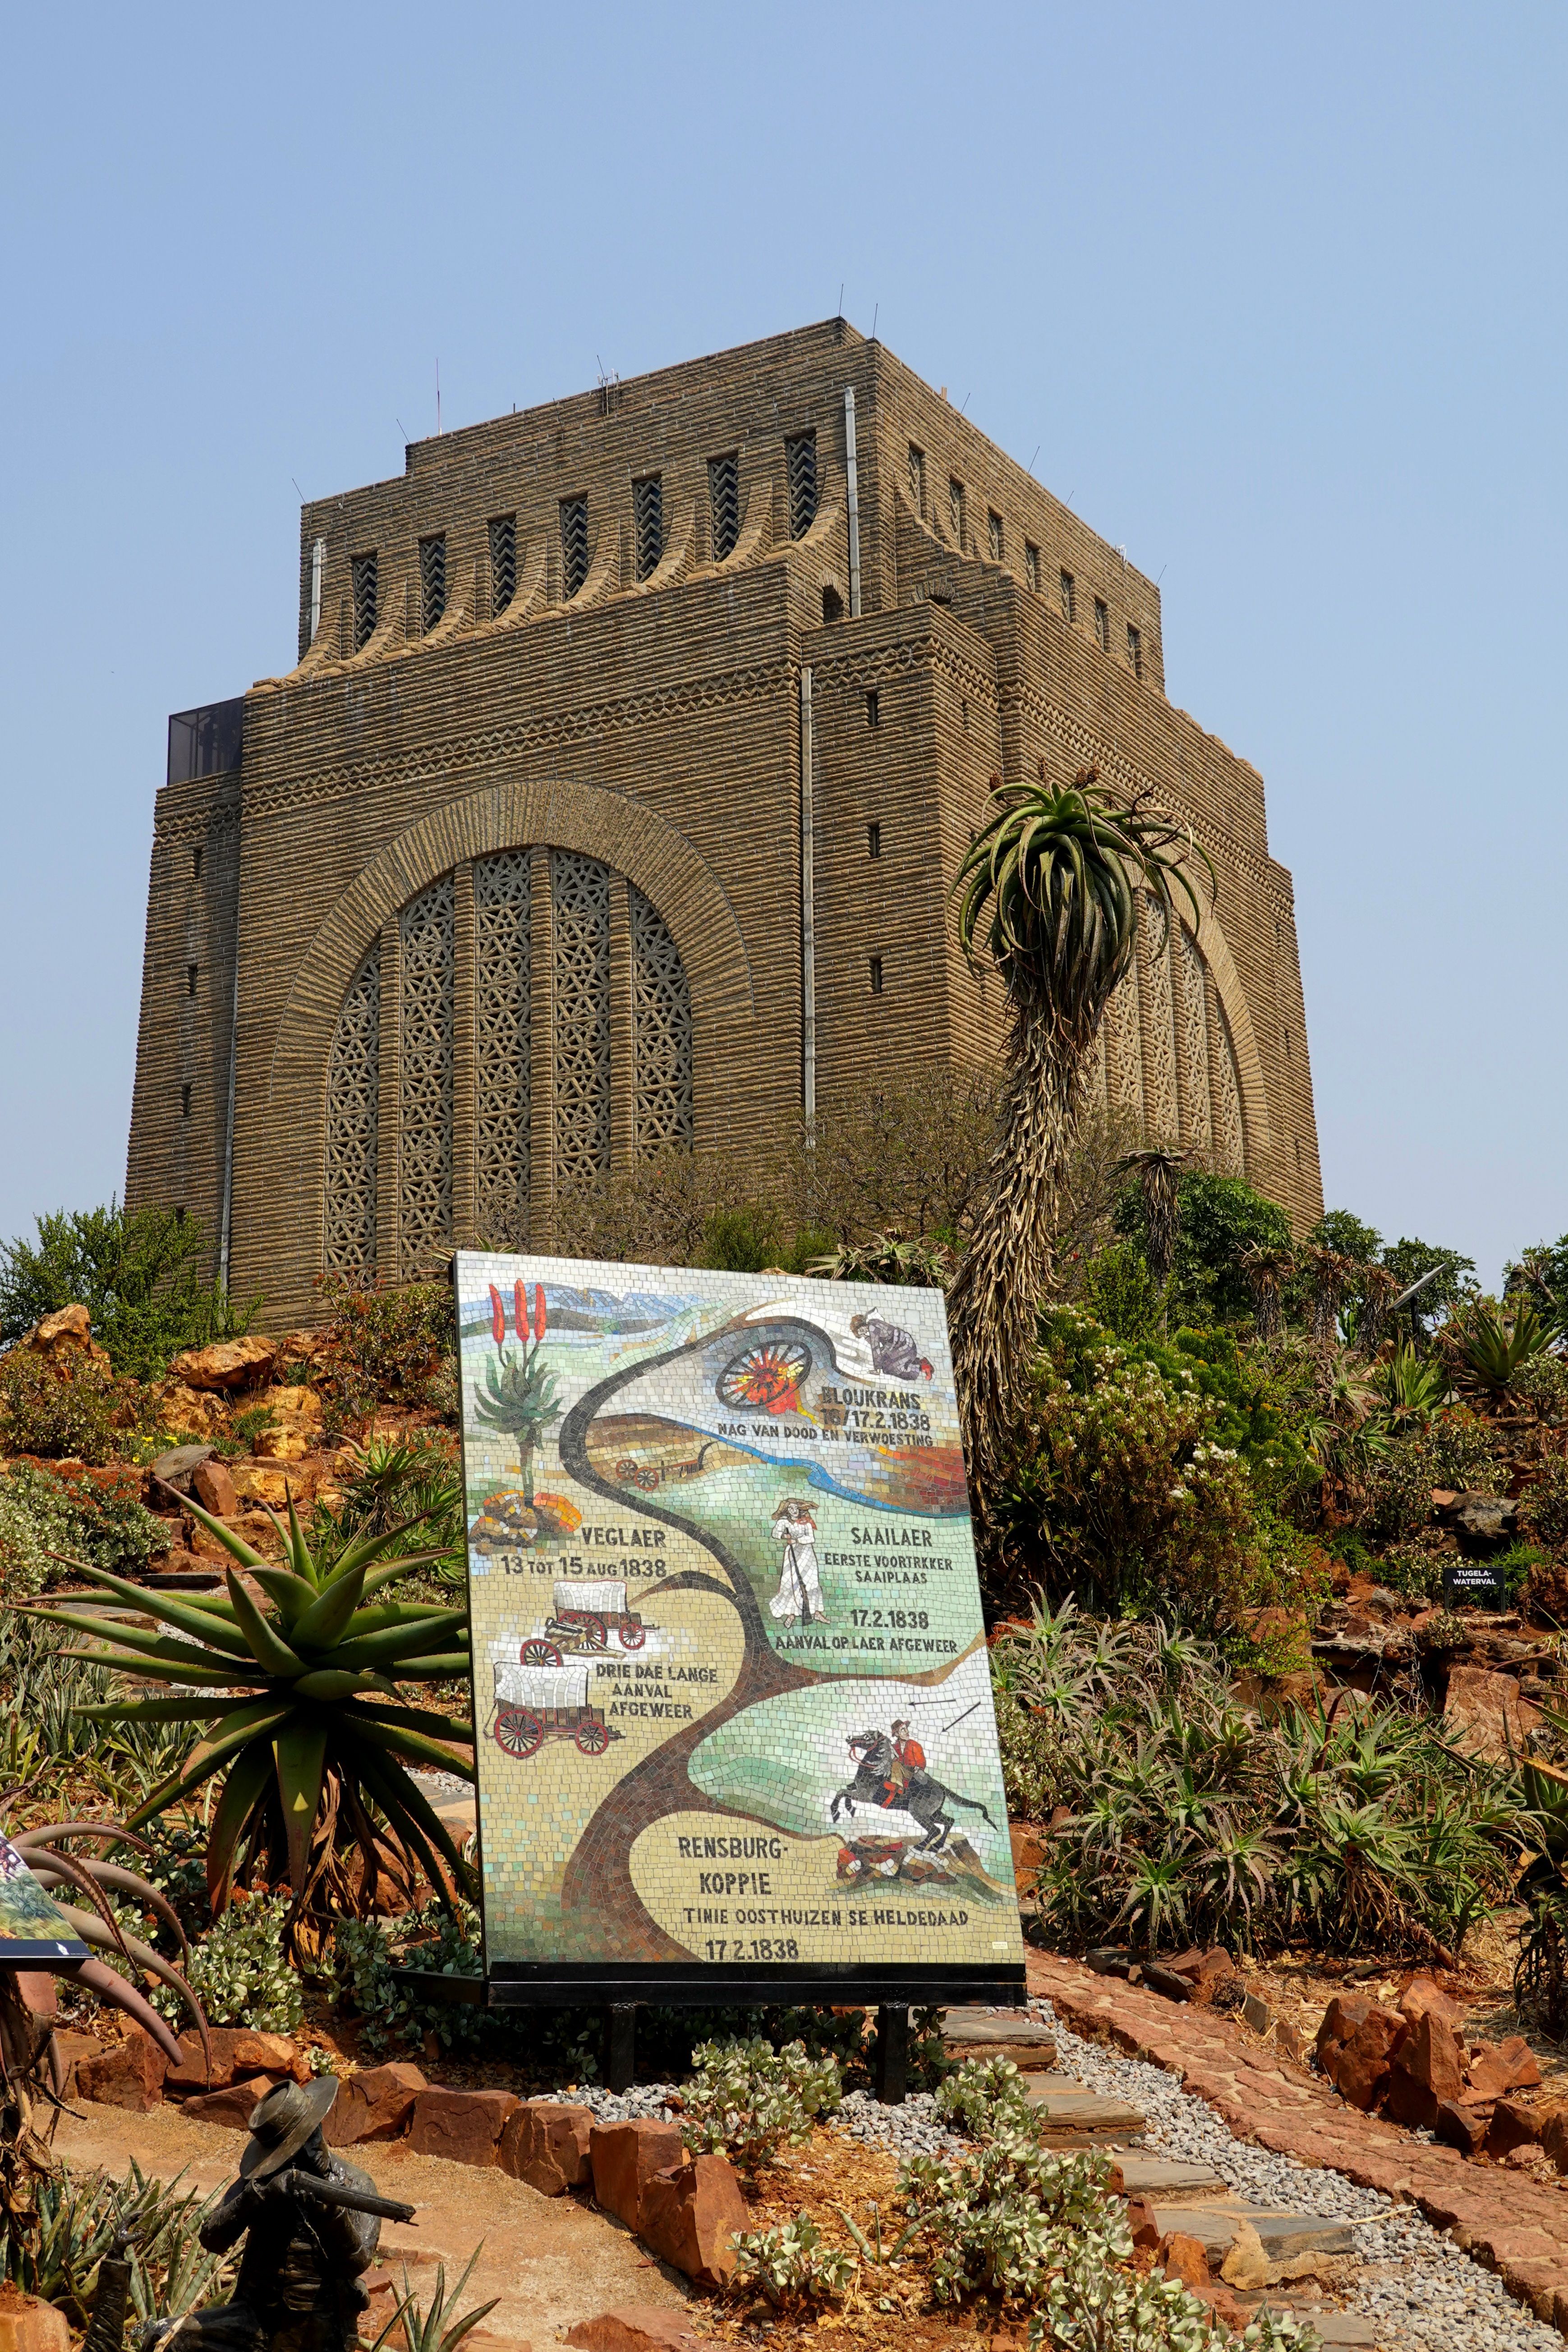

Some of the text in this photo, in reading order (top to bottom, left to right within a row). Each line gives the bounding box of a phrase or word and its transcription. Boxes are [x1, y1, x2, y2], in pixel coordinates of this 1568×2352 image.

[822, 1387, 920, 1409] BLOUKRANS
[820, 1408, 930, 1431] 16/17.2.1838
[718, 1423, 933, 1447] NAG VAN DOOD EN VERWOESTING
[582, 1527, 667, 1548] VEGLAER
[851, 1527, 932, 1547] SAAILAER
[501, 1556, 667, 1577] 13 TOT 15 AUG 1838
[824, 1553, 953, 1571] EERSTE VOORTRKKER
[855, 1571, 927, 1584] SAAIPLAAS
[851, 1609, 929, 1630] 17.2.1838
[776, 1636, 959, 1653] AANVAL OP LAER AFGEWEER
[596, 1663, 717, 1682] DRIE DAE LANGE
[612, 1683, 672, 1698] AANVAL
[610, 1702, 693, 1719] AFGEWEER
[678, 1837, 788, 1859] RENSBURG-
[700, 1873, 771, 1894] KOPPIE
[683, 1908, 968, 1926] TINIE OOSTHUIZEN SE HELDEDAAD
